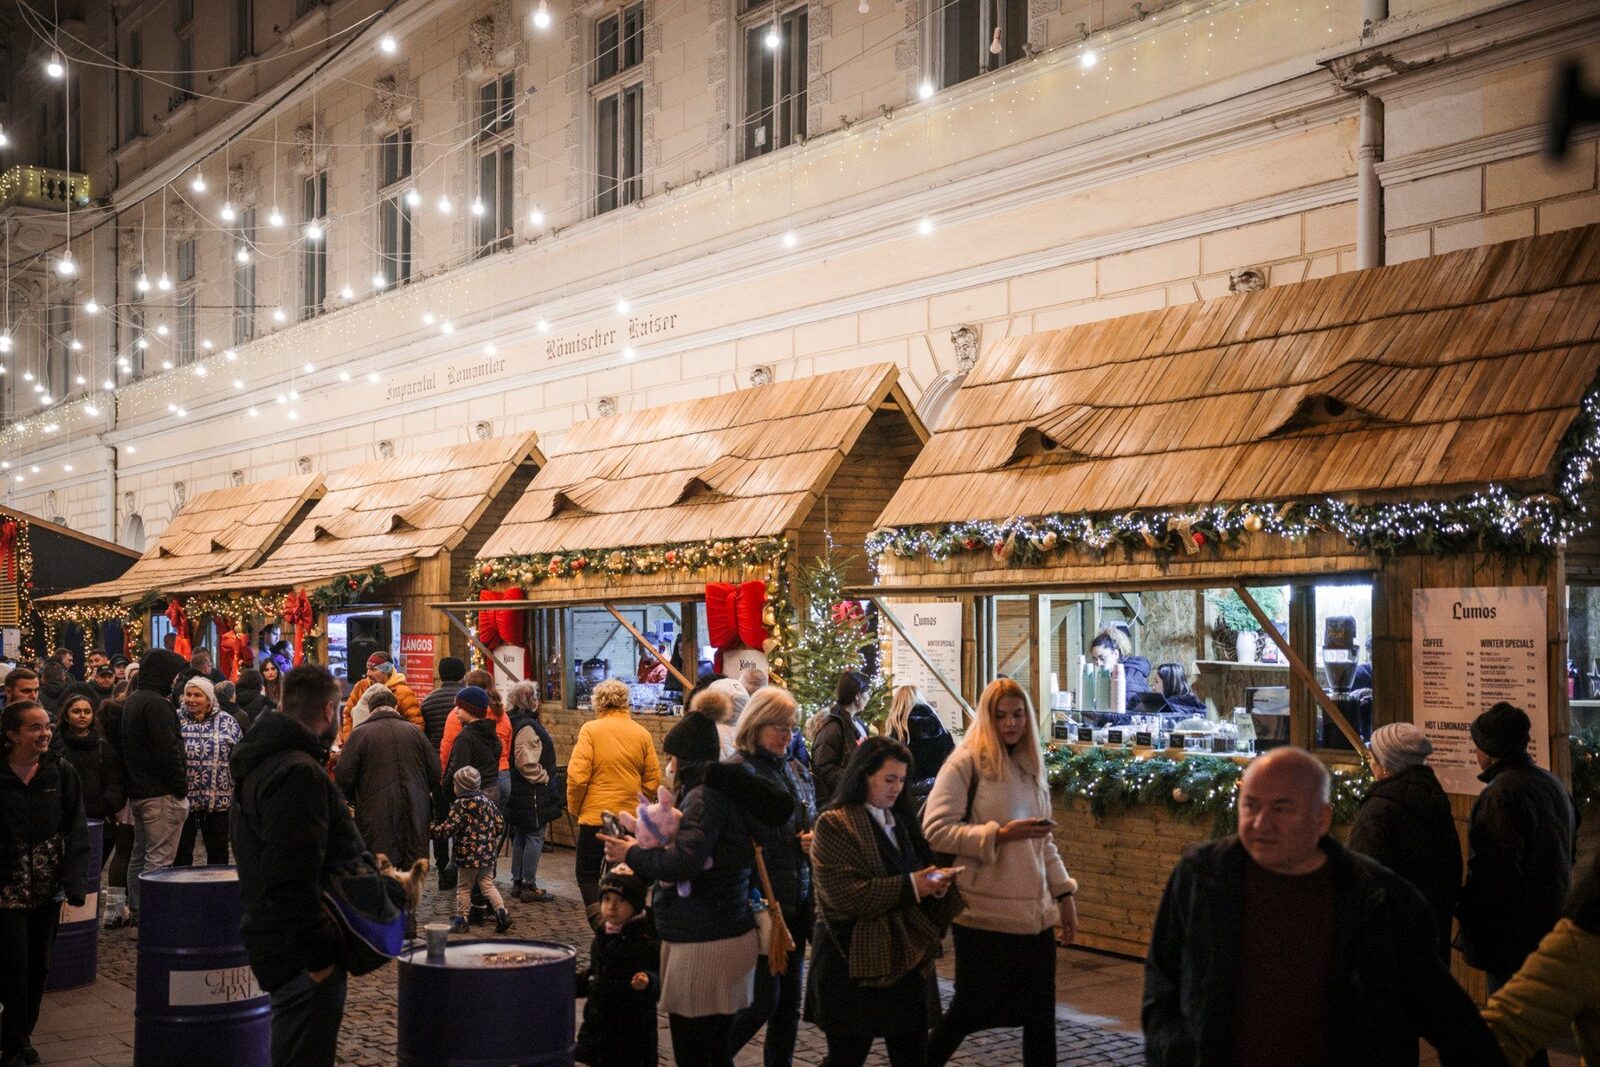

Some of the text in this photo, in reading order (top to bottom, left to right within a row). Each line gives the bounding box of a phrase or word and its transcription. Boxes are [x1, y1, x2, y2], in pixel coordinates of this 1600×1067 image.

[546, 314, 678, 361] Römischer Kaiser
[1452, 601, 1497, 620] Lumos
[1422, 639, 1444, 648] COFFEE
[1480, 639, 1535, 649] WINTER SPECIALS
[1425, 721, 1436, 730] HOT
